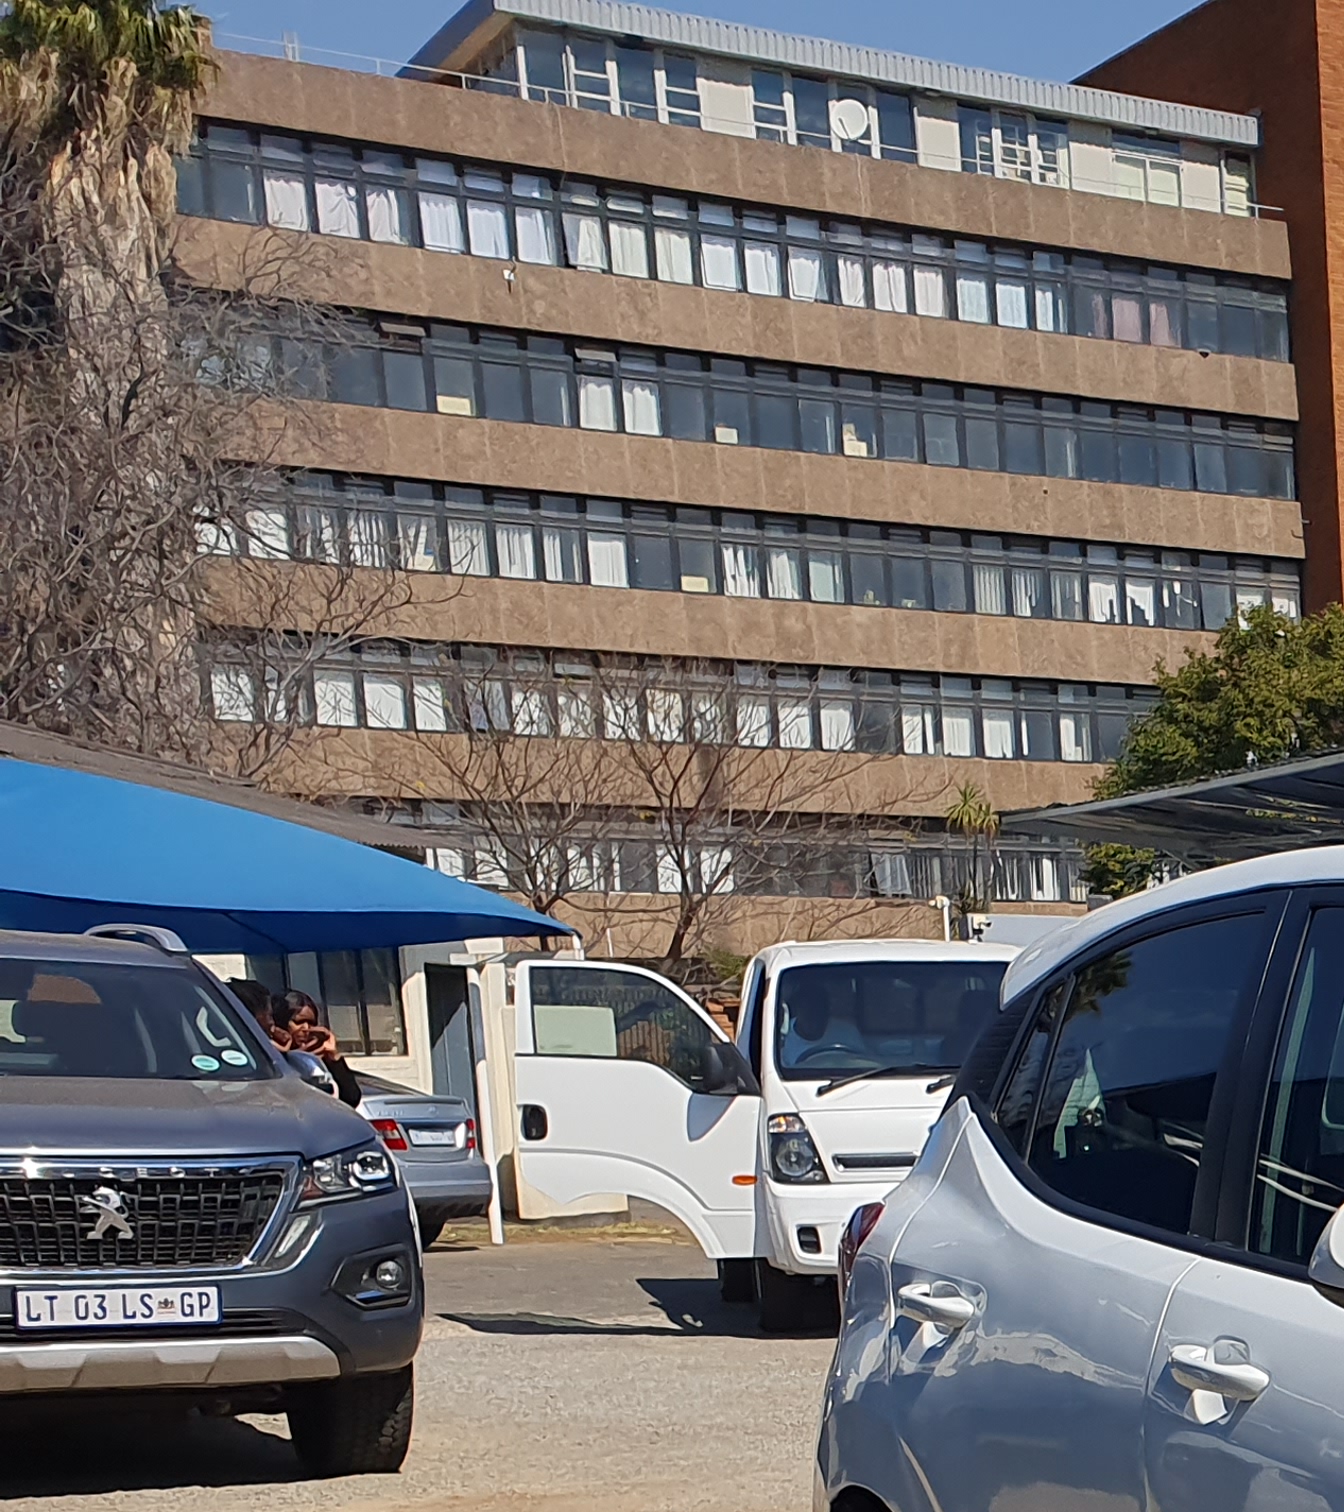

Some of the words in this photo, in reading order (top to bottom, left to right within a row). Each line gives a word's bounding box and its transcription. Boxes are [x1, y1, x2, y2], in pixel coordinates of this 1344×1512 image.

[25, 1295, 58, 1322] LT
[74, 1294, 107, 1321] 03
[121, 1293, 154, 1319] LS
[180, 1291, 211, 1317] GP
